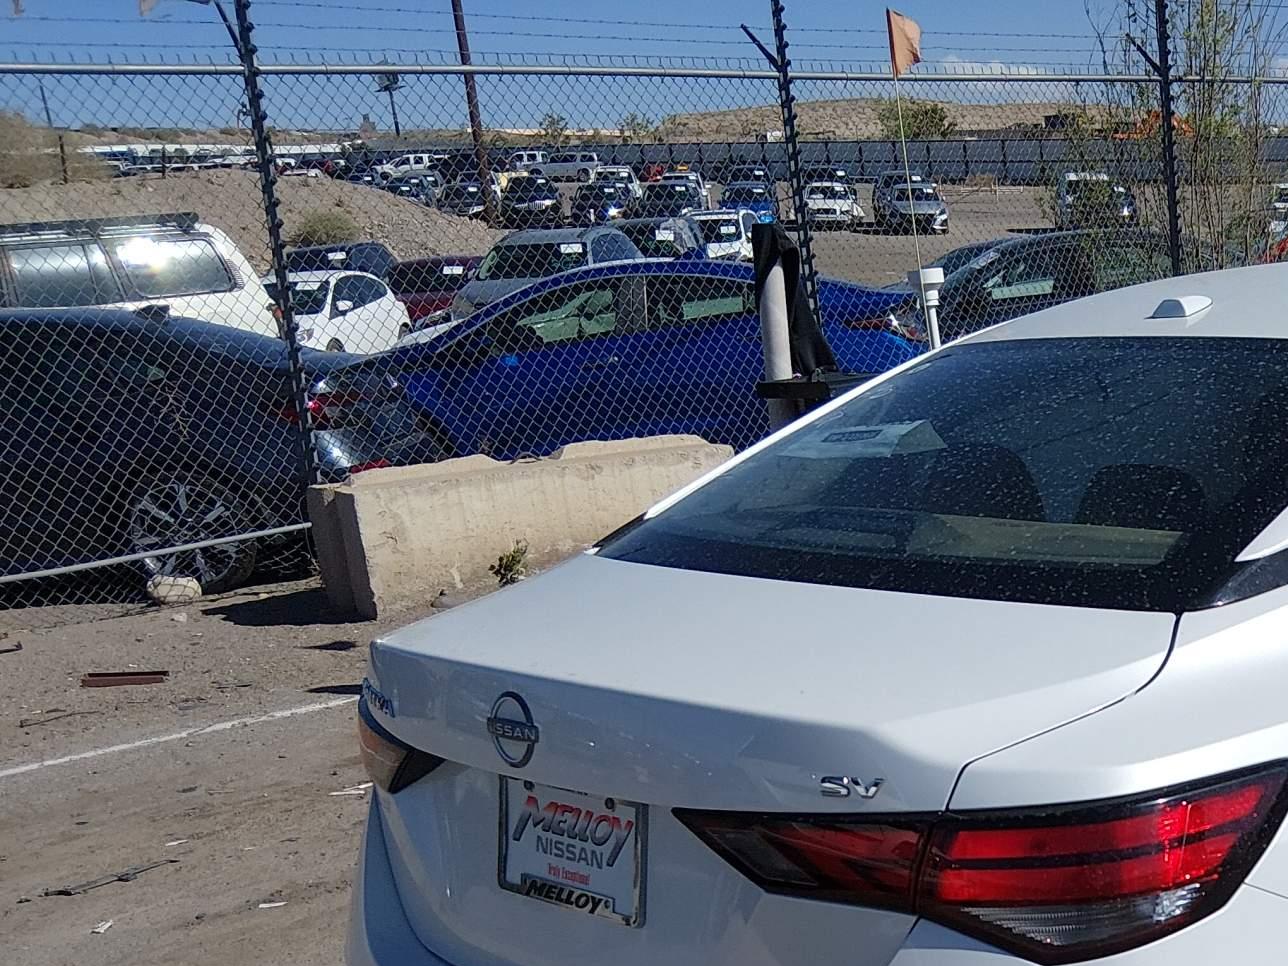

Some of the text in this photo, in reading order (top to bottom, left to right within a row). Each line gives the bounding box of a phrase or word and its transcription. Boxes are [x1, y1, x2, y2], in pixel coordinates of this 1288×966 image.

[820, 775, 887, 799] SV
[512, 795, 634, 867] MELLOY
[536, 835, 604, 869] NISSAN
[526, 879, 604, 915] MELLOY
